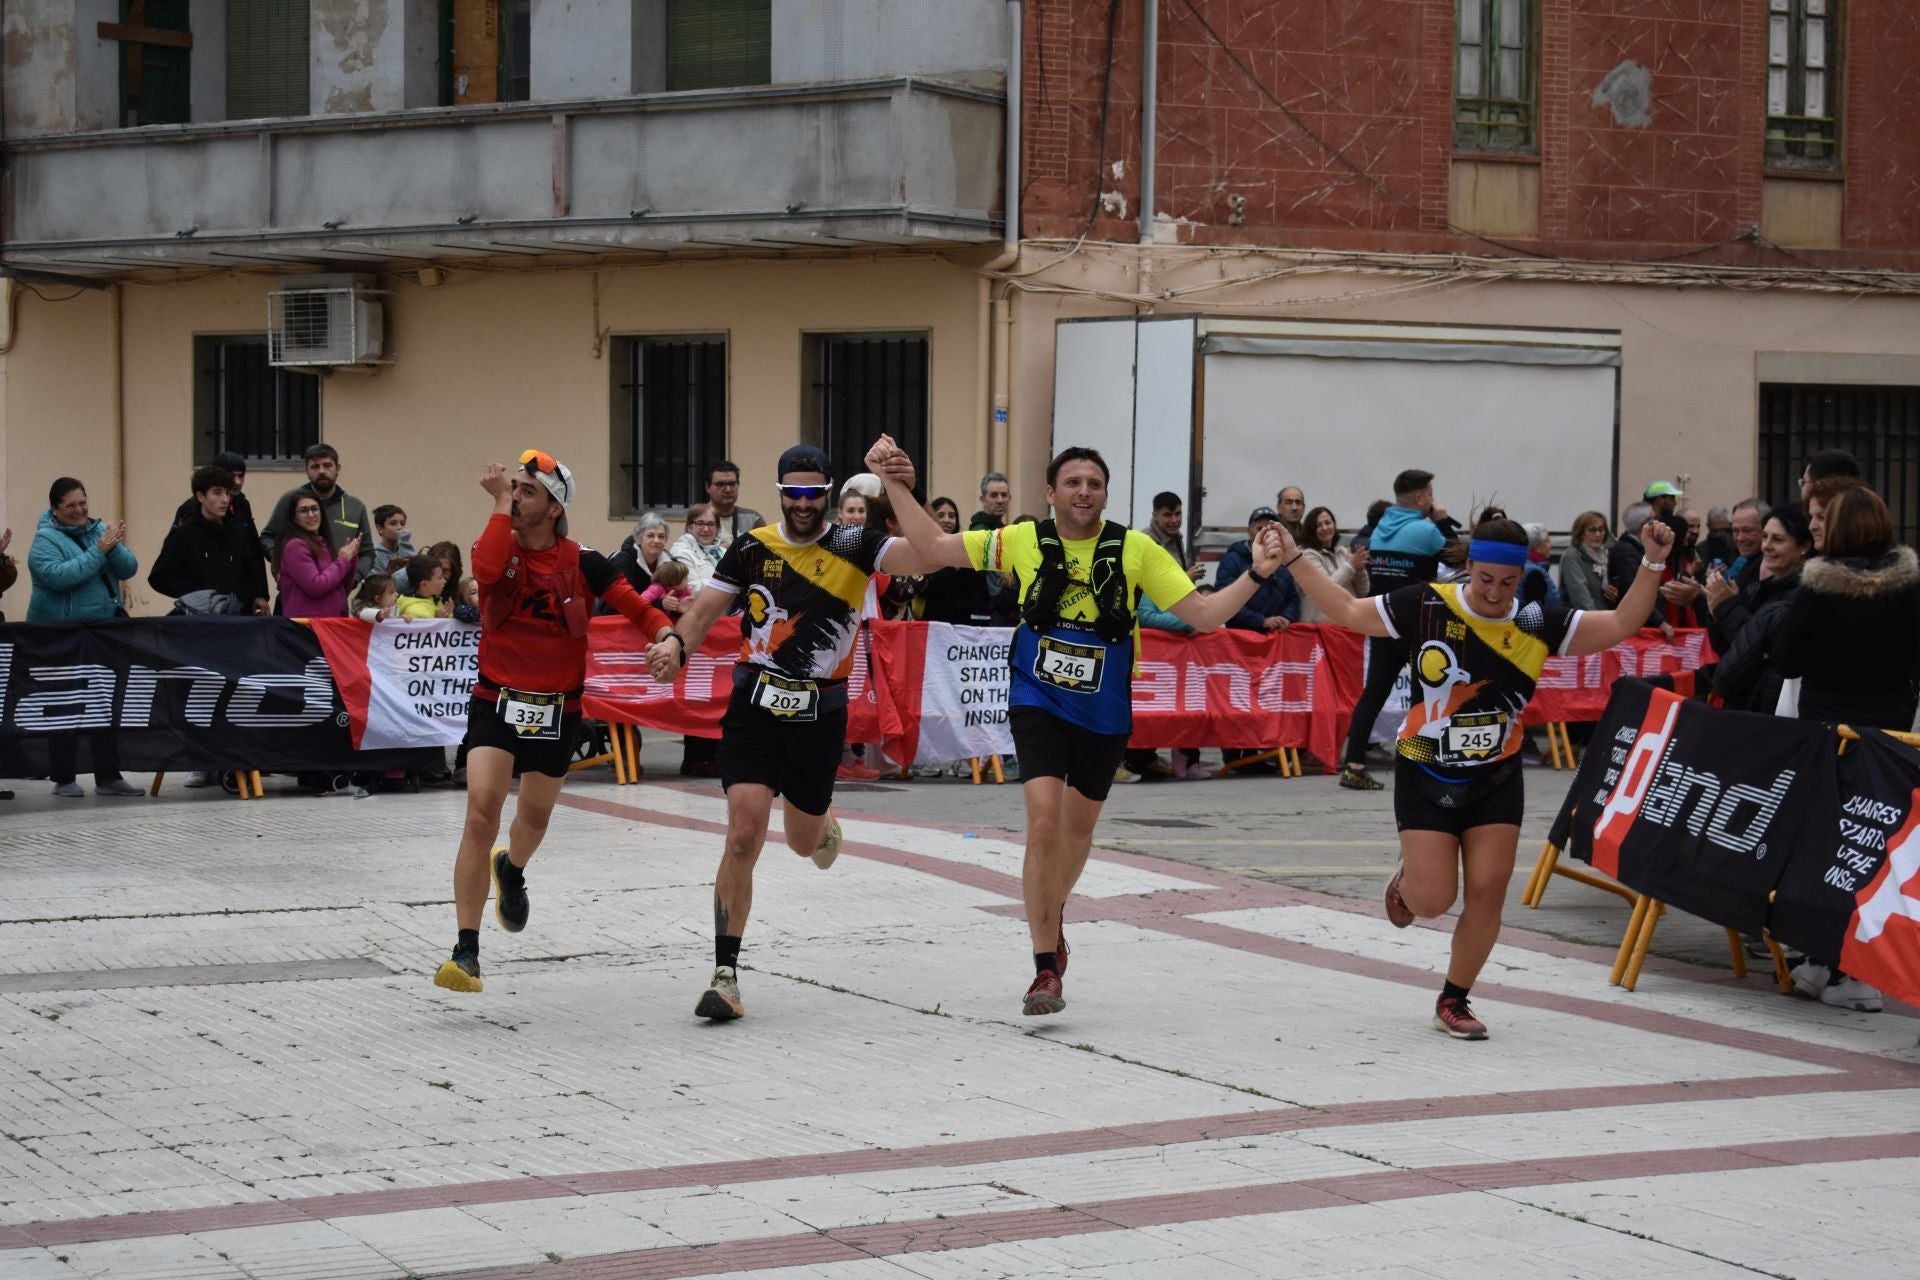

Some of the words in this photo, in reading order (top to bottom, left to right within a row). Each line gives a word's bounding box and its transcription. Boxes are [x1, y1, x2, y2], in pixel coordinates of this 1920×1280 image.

[394, 631, 482, 649] CHANGES
[947, 645, 1009, 661] CHANGE
[408, 655, 479, 672] STARTS
[1052, 659, 1085, 678] 246
[960, 667, 1009, 682] START
[408, 680, 435, 696] ON
[441, 679, 477, 695] THE
[770, 694, 801, 709] 202
[961, 689, 983, 704] ON
[988, 688, 1008, 703] TH
[515, 708, 545, 724] 332
[965, 709, 1009, 727] INSID
[1460, 732, 1492, 748] 245
